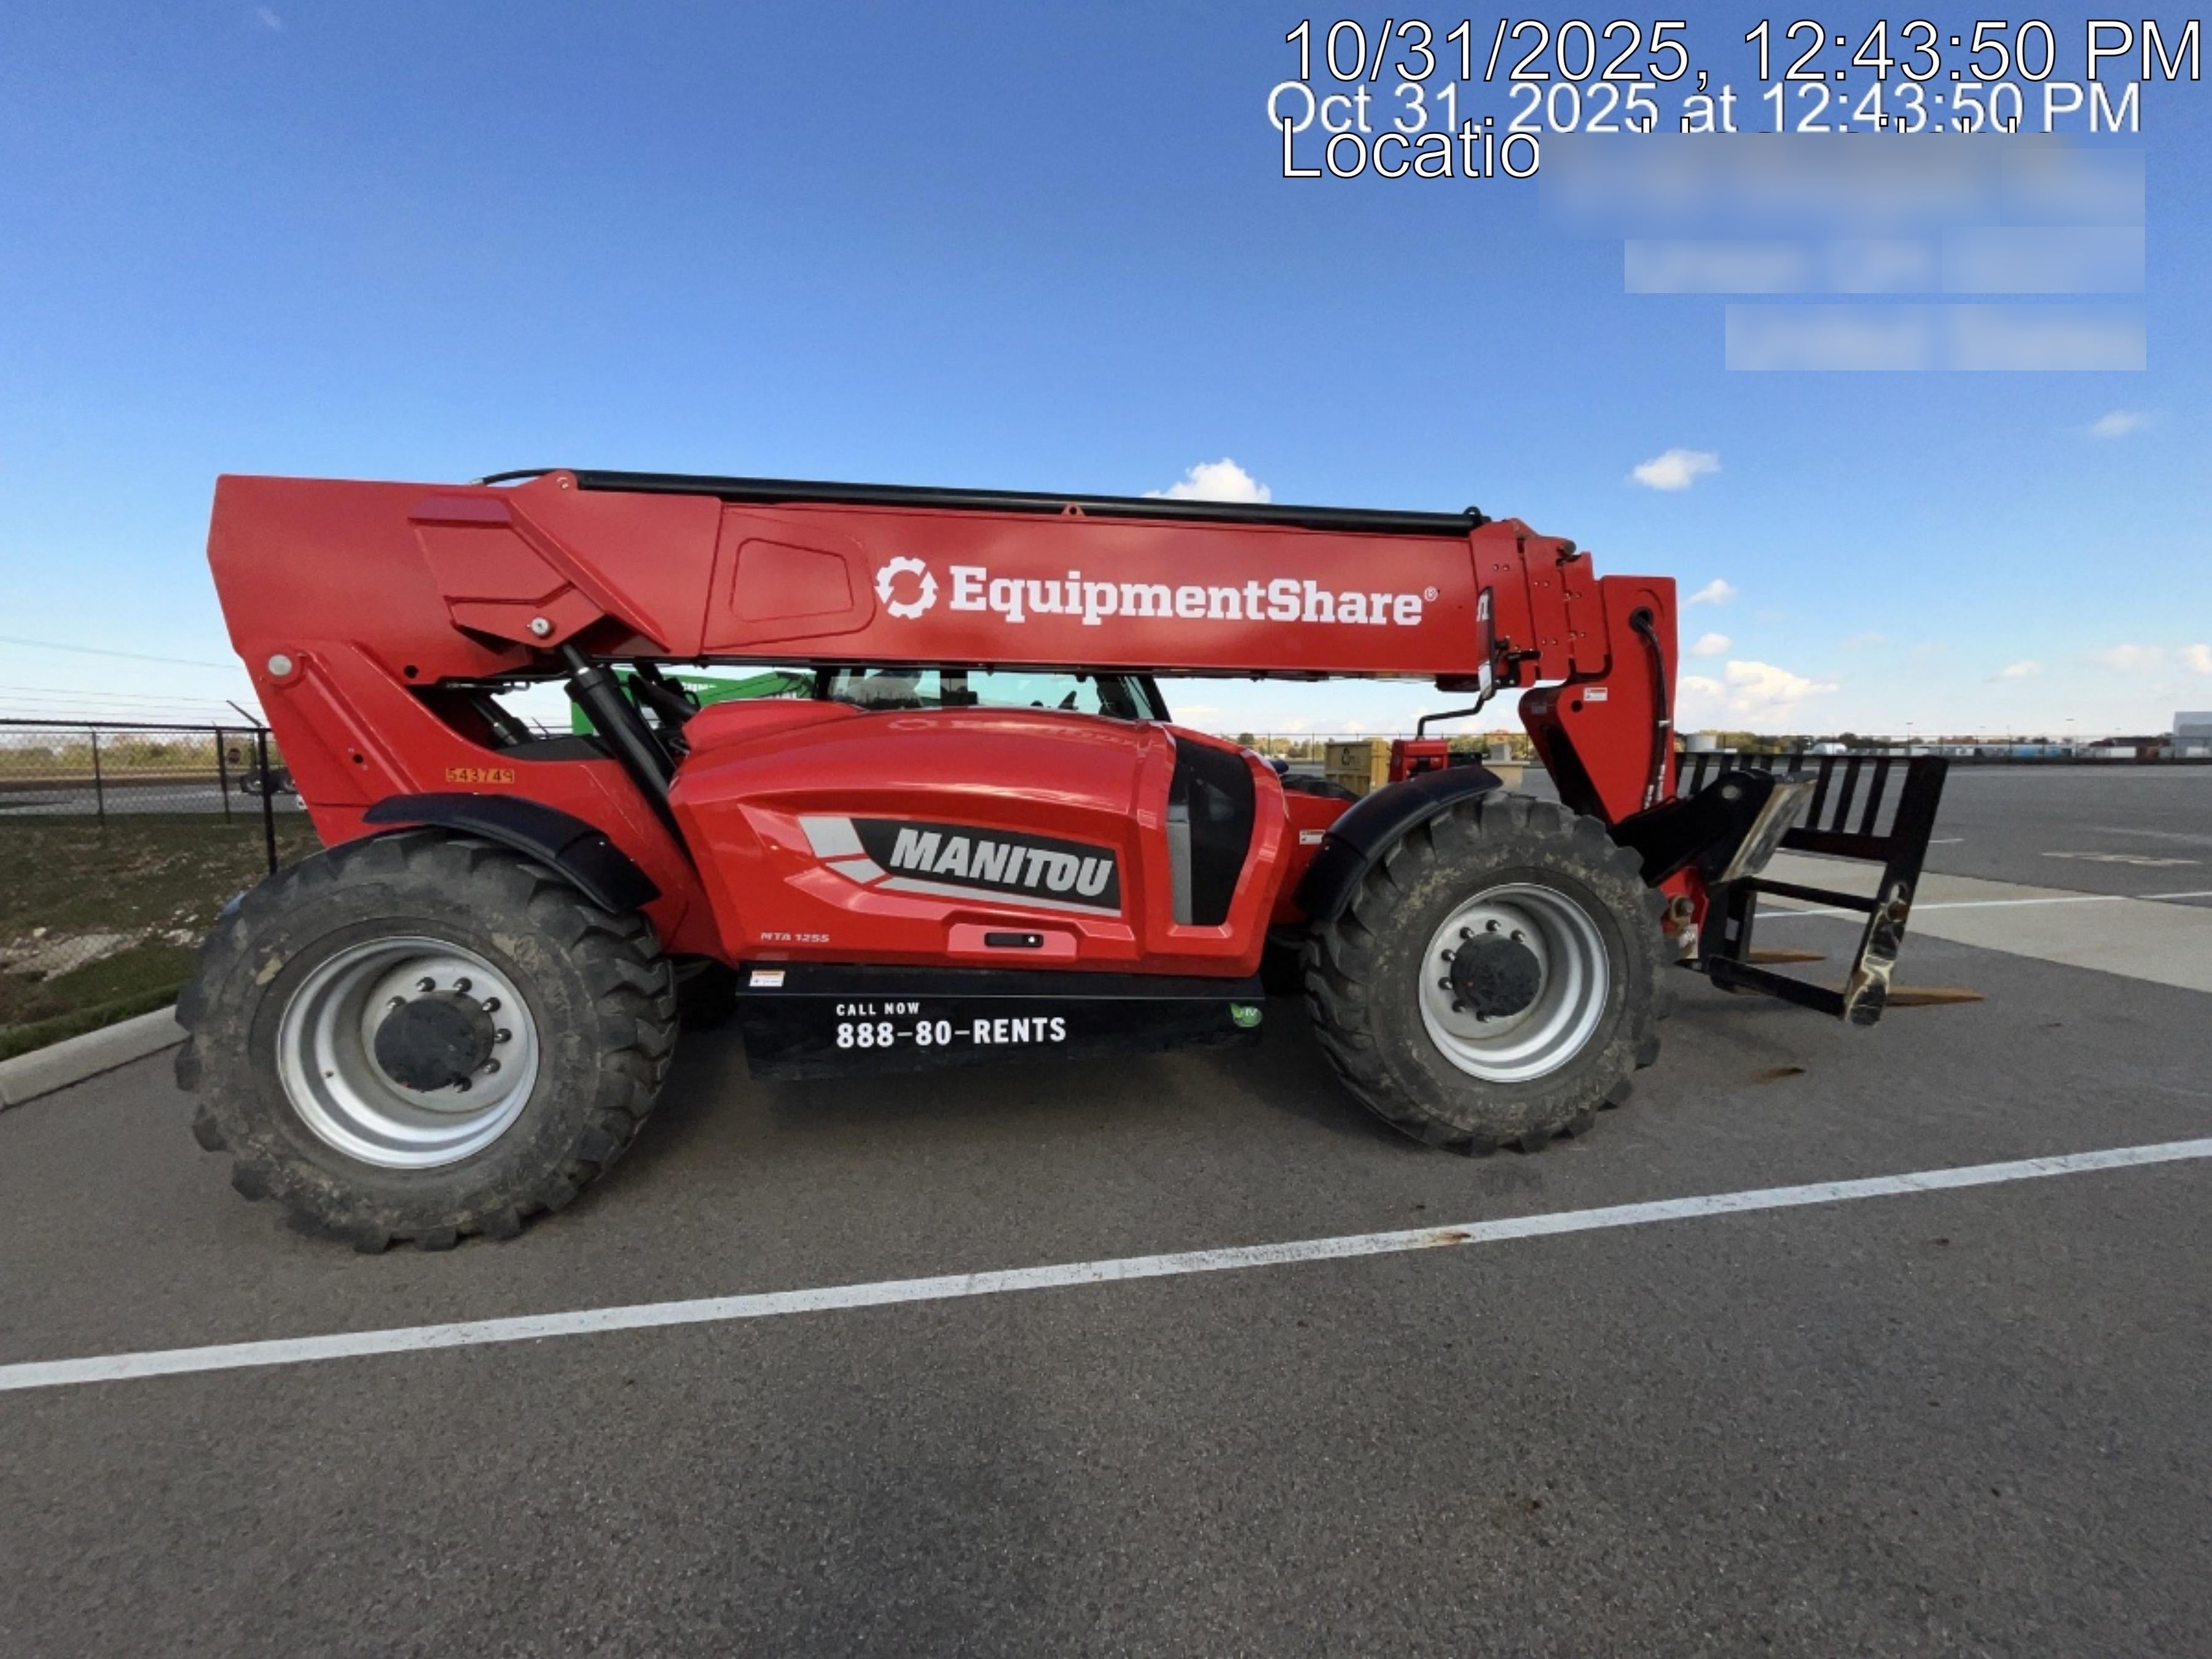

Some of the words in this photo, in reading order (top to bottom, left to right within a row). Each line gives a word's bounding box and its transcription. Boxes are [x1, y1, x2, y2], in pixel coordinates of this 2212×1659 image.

[890, 827, 1113, 896] MANITOU
[761, 932, 791, 941] MTA
[795, 934, 830, 943] 1255
[836, 1004, 876, 1016] CALL
[885, 1003, 919, 1014] NOW
[837, 1018, 1066, 1048] 888-80-RENTS
